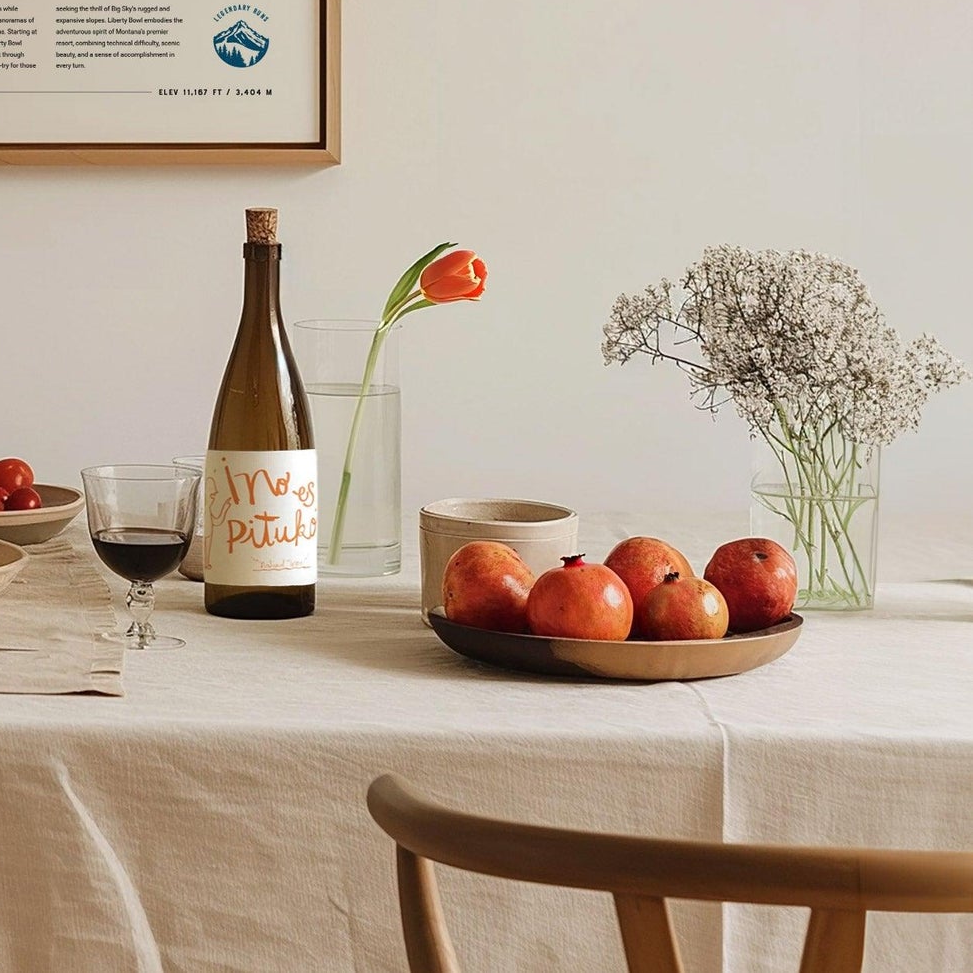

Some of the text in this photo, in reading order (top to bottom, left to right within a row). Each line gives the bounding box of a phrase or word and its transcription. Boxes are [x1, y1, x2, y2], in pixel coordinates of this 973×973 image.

[56, 5, 78, 13] seeking
[111, 5, 120, 13] Big
[138, 5, 158, 13] rugged
[213, 4, 269, 22] LEGENDARY RUNS
[56, 17, 84, 25] expansive
[108, 17, 127, 25] Liberty
[7, 28, 30, 36] Starting
[93, 28, 107, 36] spirit
[147, 28, 168, 36] premier
[2, 51, 24, 59] through
[121, 51, 168, 59] accomplishment
